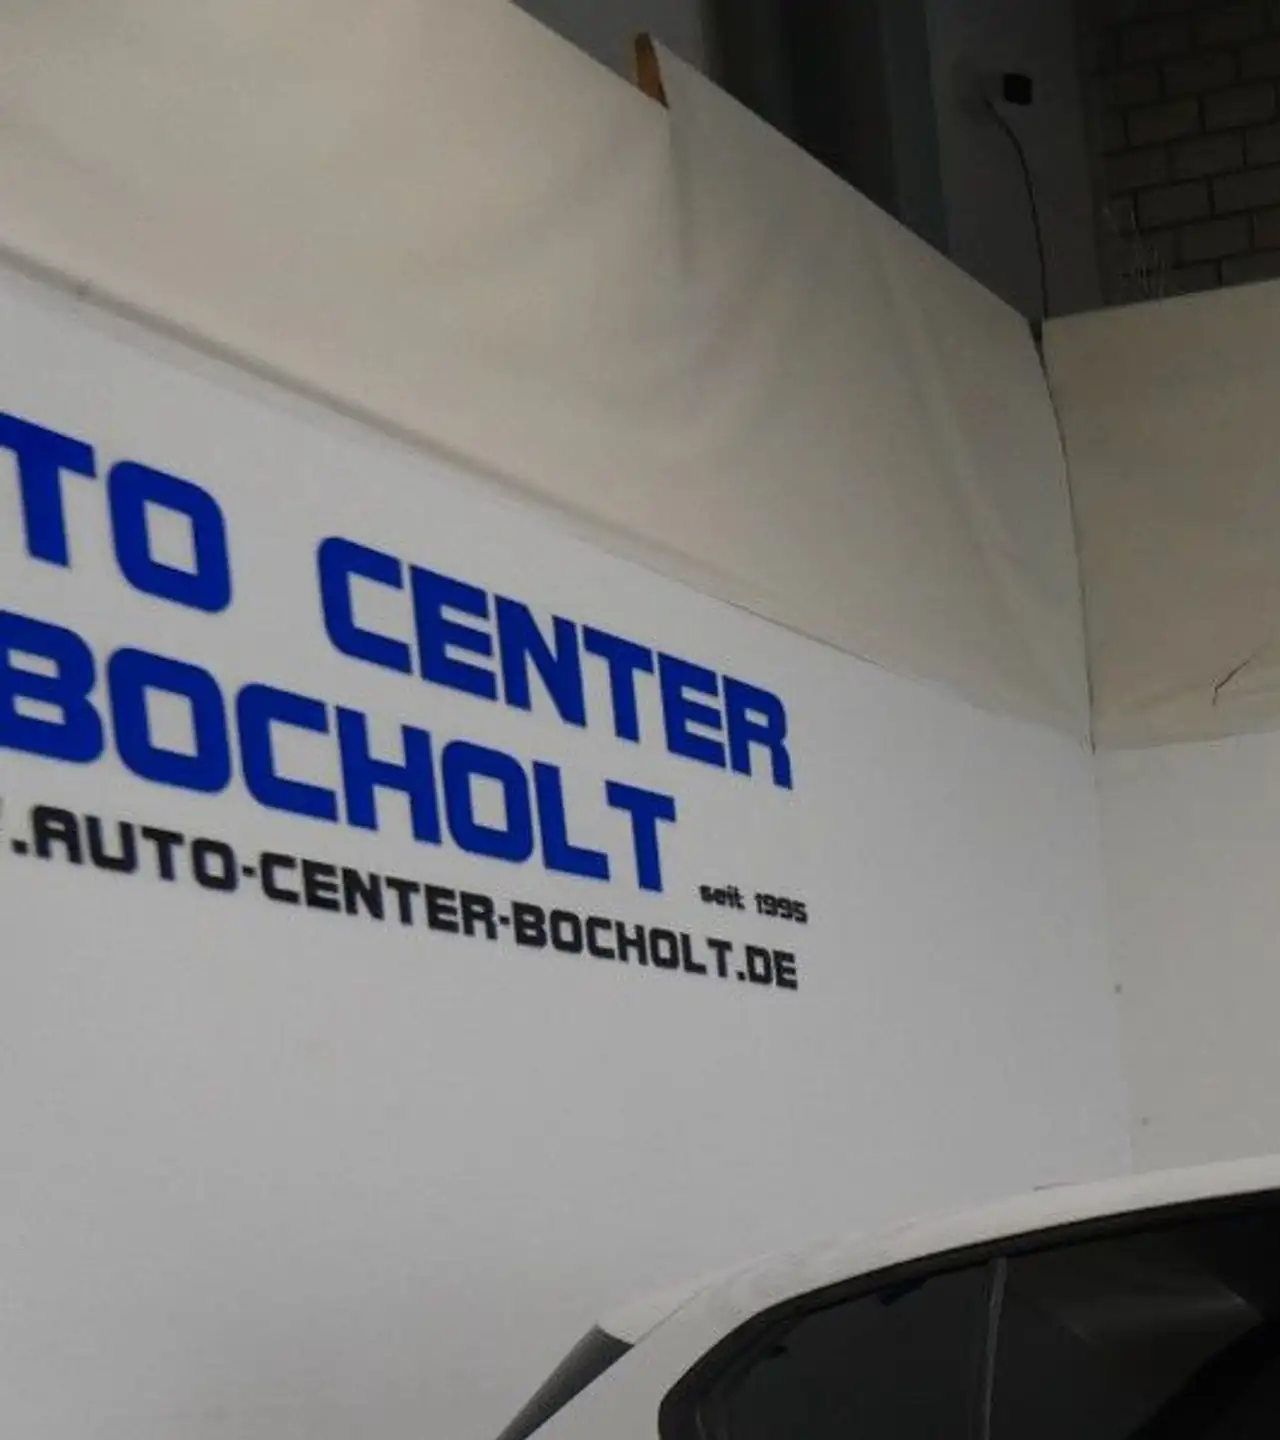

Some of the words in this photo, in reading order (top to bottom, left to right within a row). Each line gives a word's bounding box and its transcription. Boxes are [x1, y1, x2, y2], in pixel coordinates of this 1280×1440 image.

[0, 611, 677, 893] BOCHOLT
[319, 538, 792, 789] CENTER
[0, 798, 799, 992] .AUTO-CENTER-BOCHOLT.DE
[754, 892, 808, 924] 1995
